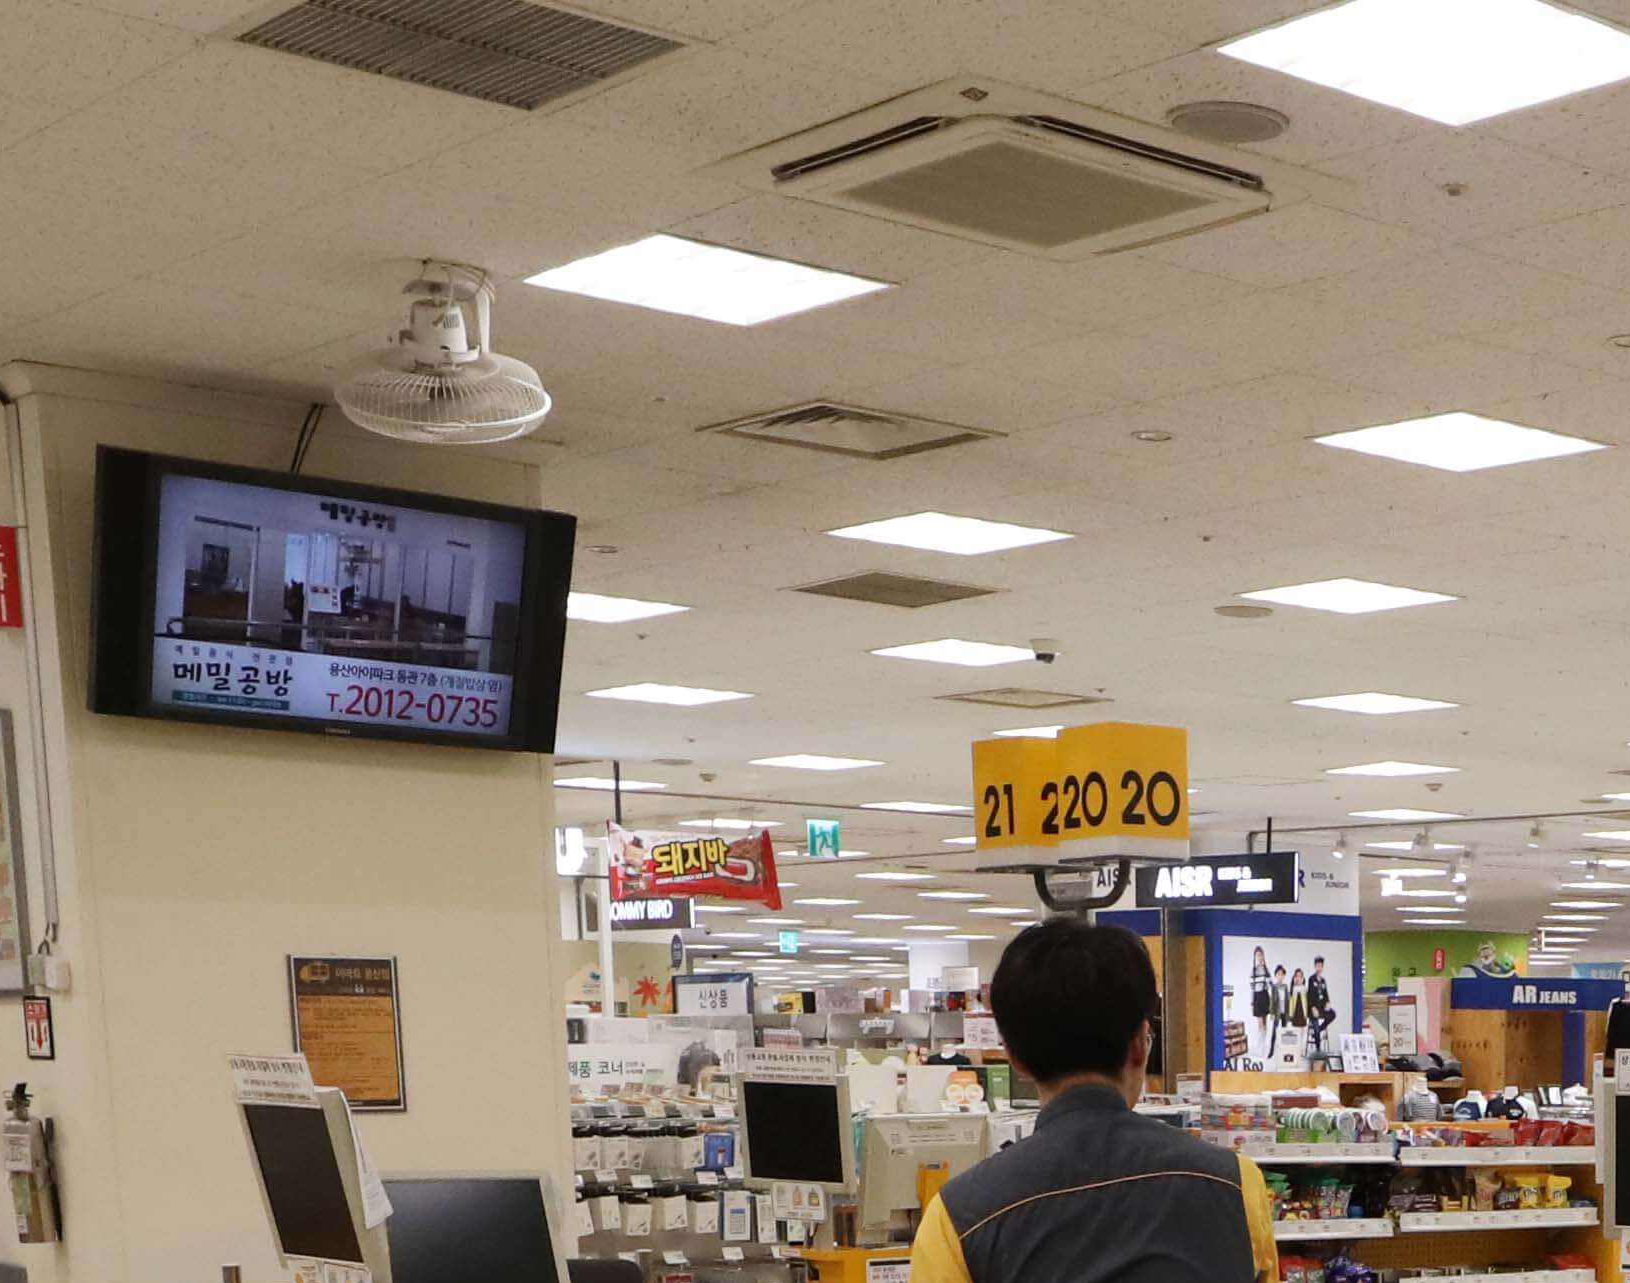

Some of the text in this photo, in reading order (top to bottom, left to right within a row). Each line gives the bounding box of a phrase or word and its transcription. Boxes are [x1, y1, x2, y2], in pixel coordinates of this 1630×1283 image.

[172, 661, 293, 698] 메밀공방
[326, 683, 499, 729] T.2012-0735
[984, 783, 1015, 838] 21
[1064, 771, 1107, 830] 20
[1121, 769, 1180, 827] 20
[652, 838, 730, 876] 돼지바
[1154, 865, 1213, 899] AISR
[647, 899, 673, 919] BIRD
[699, 988, 728, 1009] 신상품
[1512, 985, 1577, 1005] AR JEANS
[597, 1059, 623, 1076] 코너
